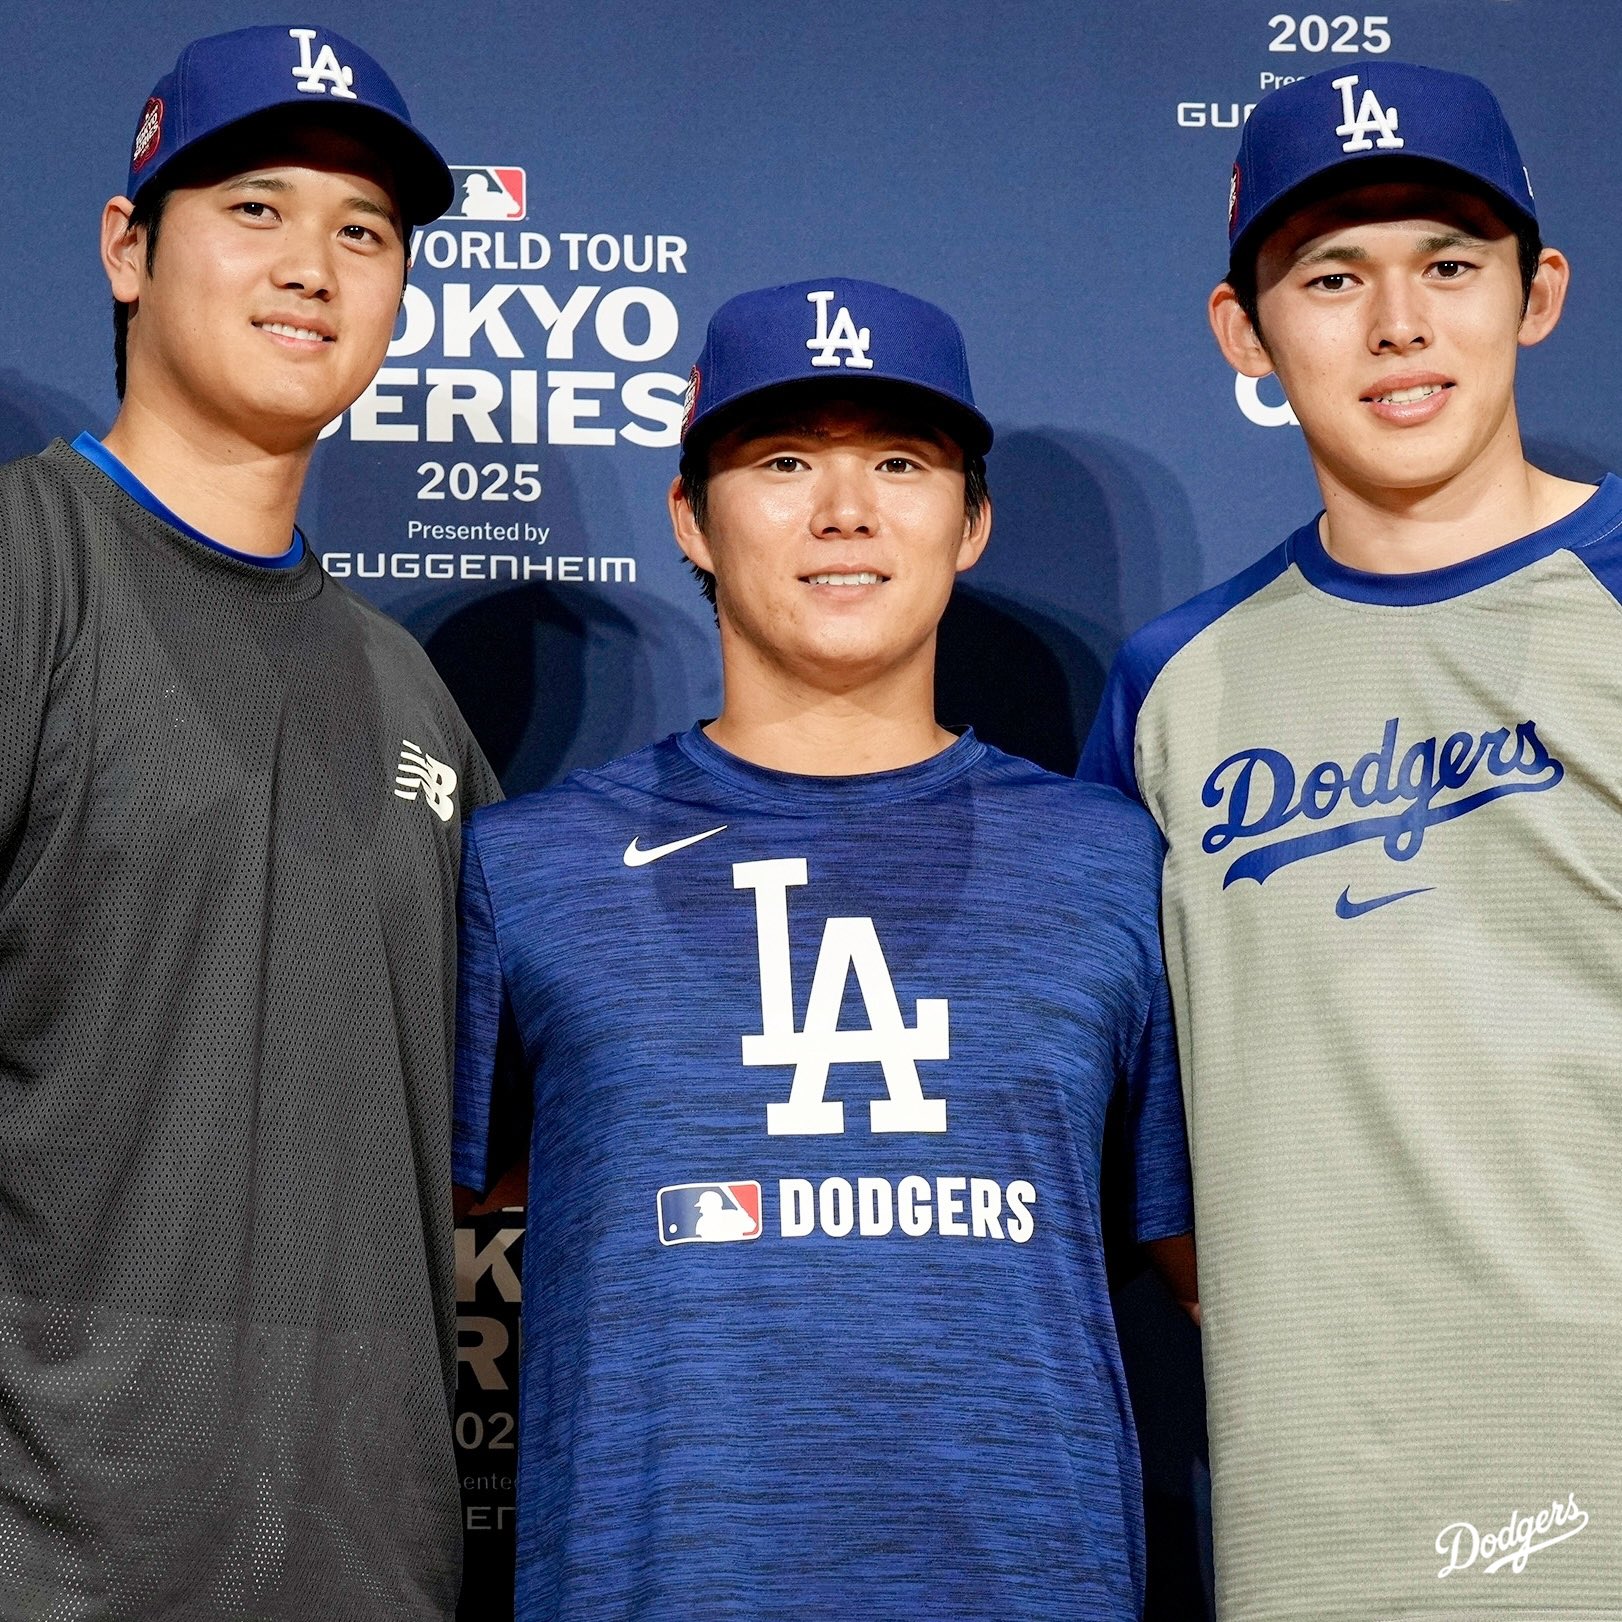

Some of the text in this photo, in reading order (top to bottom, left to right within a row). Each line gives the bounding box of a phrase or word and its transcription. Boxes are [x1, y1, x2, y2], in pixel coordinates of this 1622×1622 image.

[289, 28, 358, 99] LA
[1267, 14, 1392, 54] 2025
[1332, 75, 1404, 153] LA
[410, 230, 688, 273] ORLD TOUR
[806, 291, 873, 369] LA
[317, 367, 688, 448] ERIES
[416, 461, 542, 502] 2025
[408, 520, 550, 545] Presented by
[322, 552, 637, 583] GUGGENHEIM
[1201, 717, 1564, 890] Dodgers
[732, 858, 950, 1135] LA
[779, 1175, 1036, 1243] DODGERS
